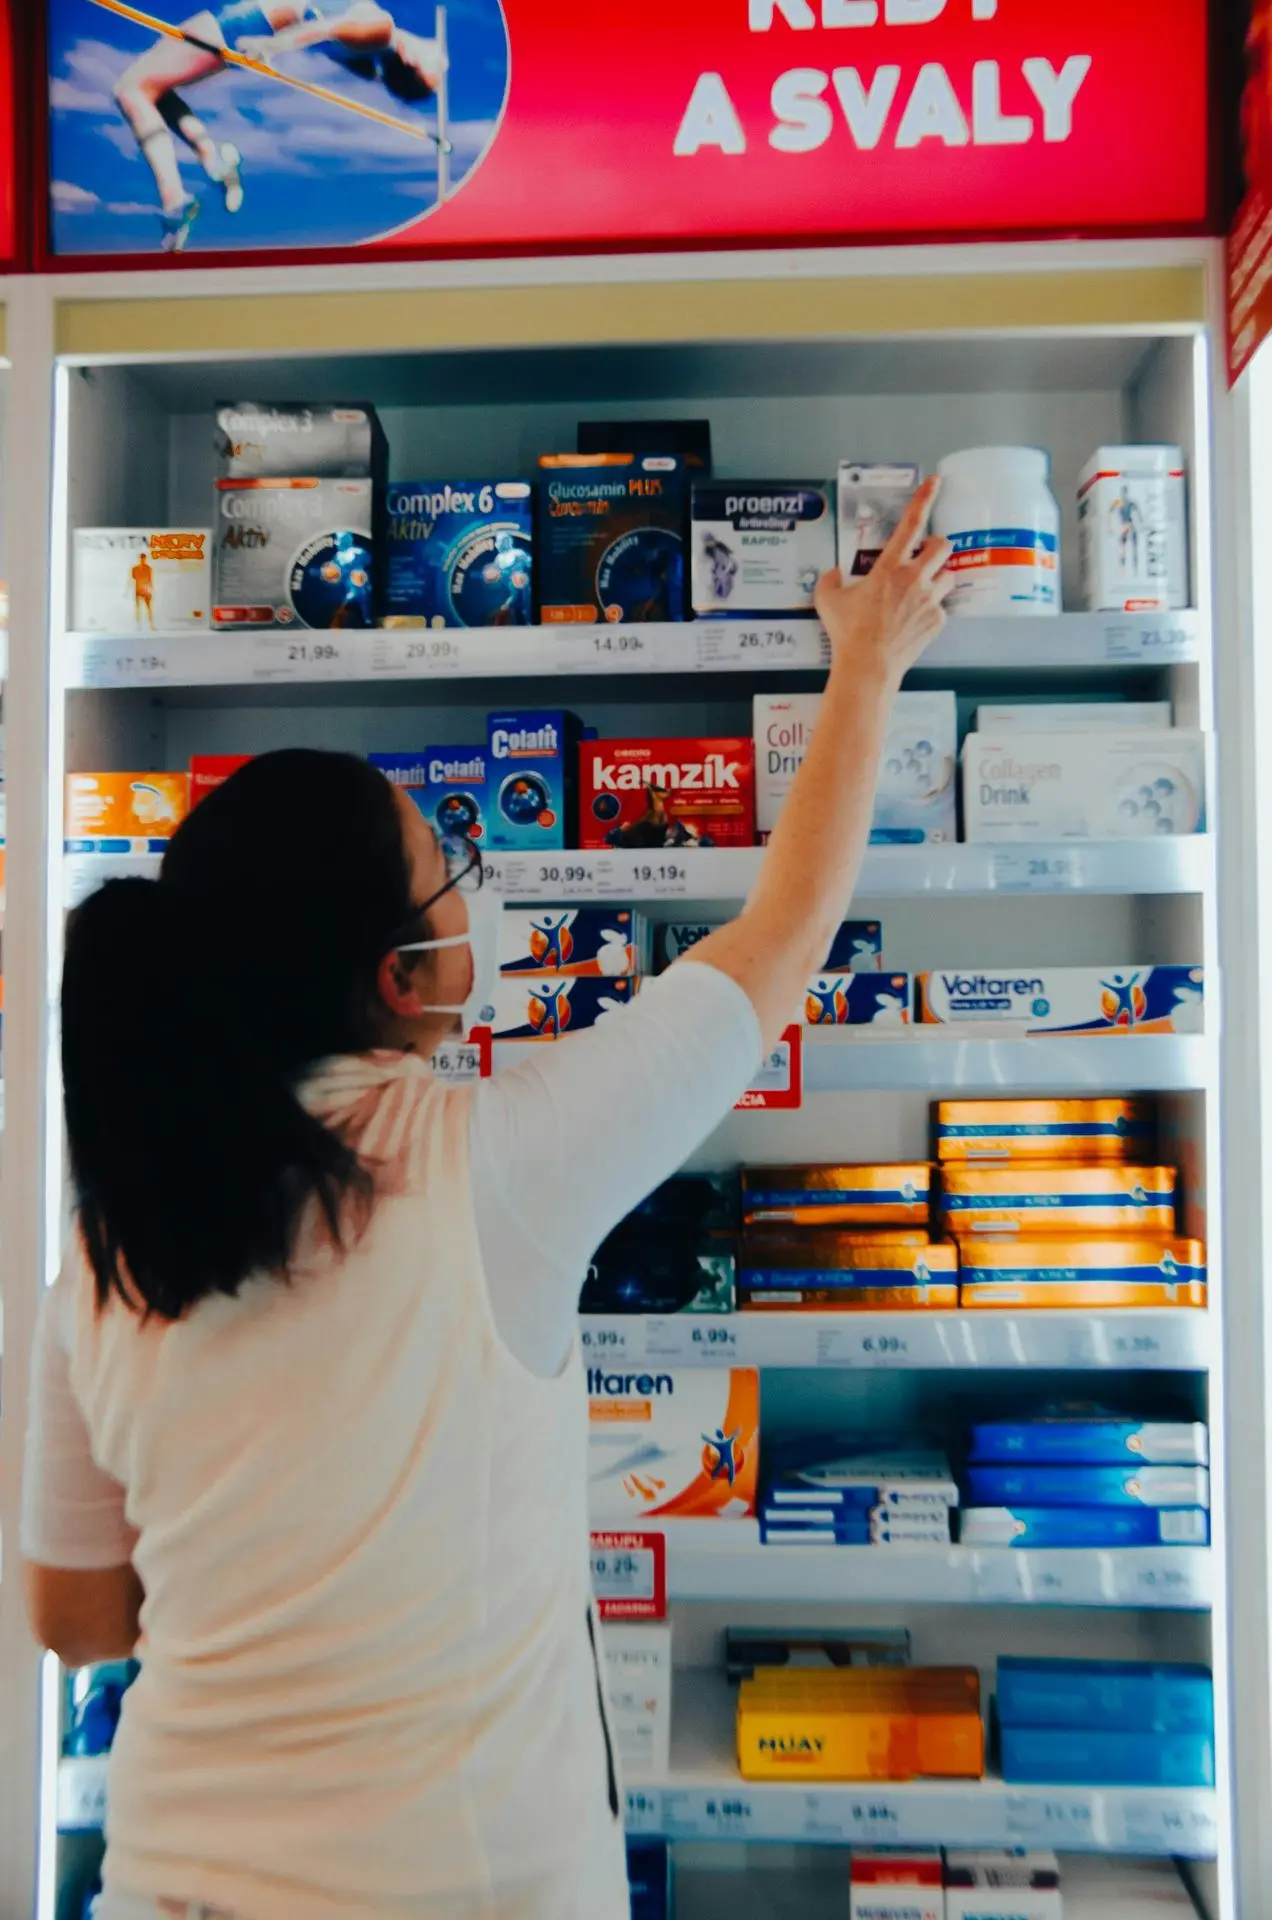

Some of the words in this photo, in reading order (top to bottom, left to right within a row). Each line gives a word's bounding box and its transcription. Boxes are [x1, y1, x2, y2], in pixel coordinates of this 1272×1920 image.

[673, 72, 746, 155] A
[768, 55, 1092, 152] SVALY
[549, 480, 626, 499] Glucosamin
[629, 478, 663, 496] PLUS
[386, 484, 475, 520] Complex
[478, 485, 494, 514] 6
[725, 492, 804, 516] proenzi
[387, 517, 434, 541] Aktiv
[739, 630, 797, 649] 26,79€
[492, 723, 558, 759] Colafit
[379, 763, 426, 784] olafit
[592, 753, 741, 790] kamzík
[979, 783, 1030, 806] Drink
[539, 865, 593, 883] 30,99€
[633, 865, 686, 882] 19,19€
[941, 974, 1045, 996] Voltaren
[587, 1368, 673, 1396] ltaren
